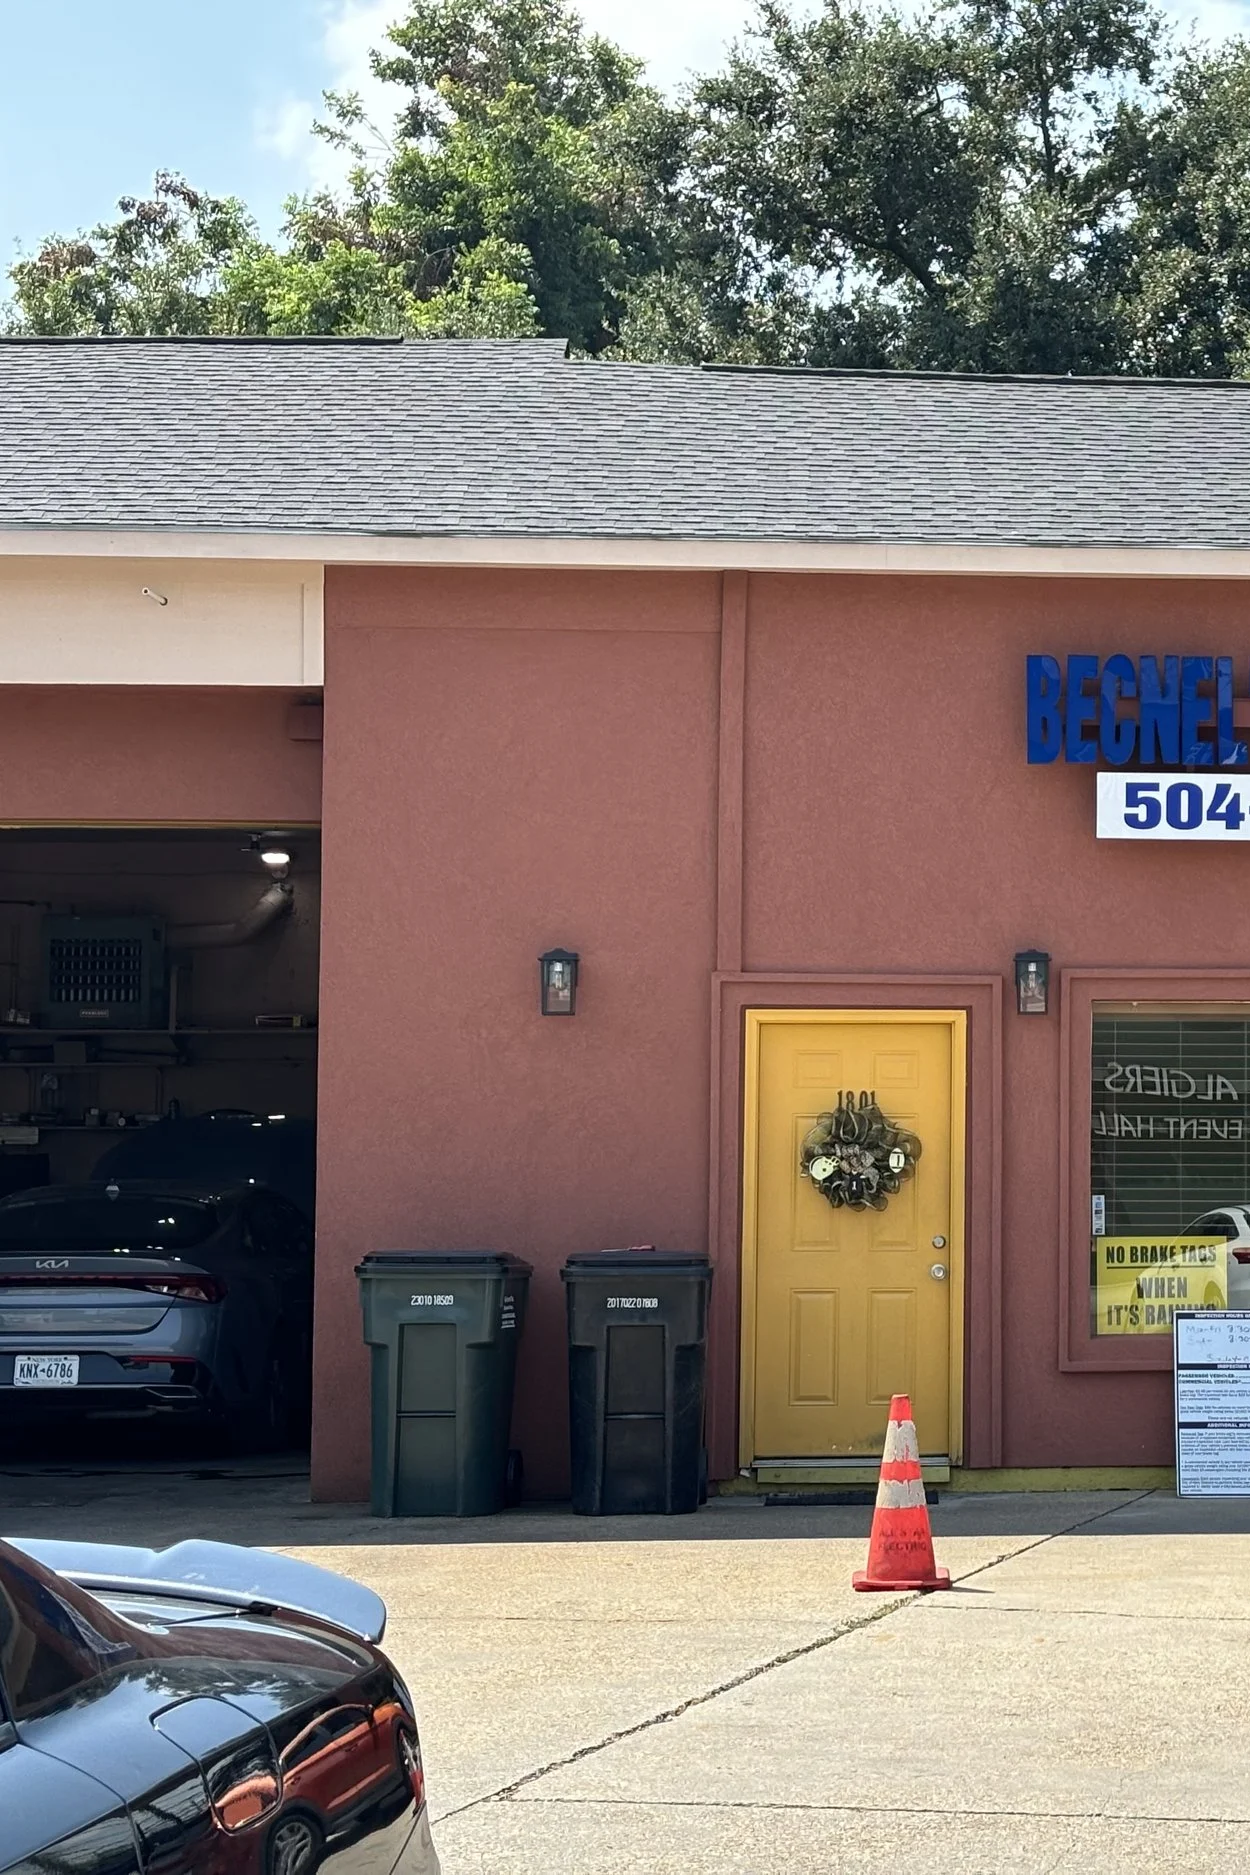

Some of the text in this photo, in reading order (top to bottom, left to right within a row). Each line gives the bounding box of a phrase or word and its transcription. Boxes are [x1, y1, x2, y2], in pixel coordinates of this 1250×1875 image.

[1106, 1245, 1216, 1263] NO BRAKE TAGS
[1136, 1277, 1187, 1298] WHEN
[1107, 1305, 1139, 1325] IT'S
